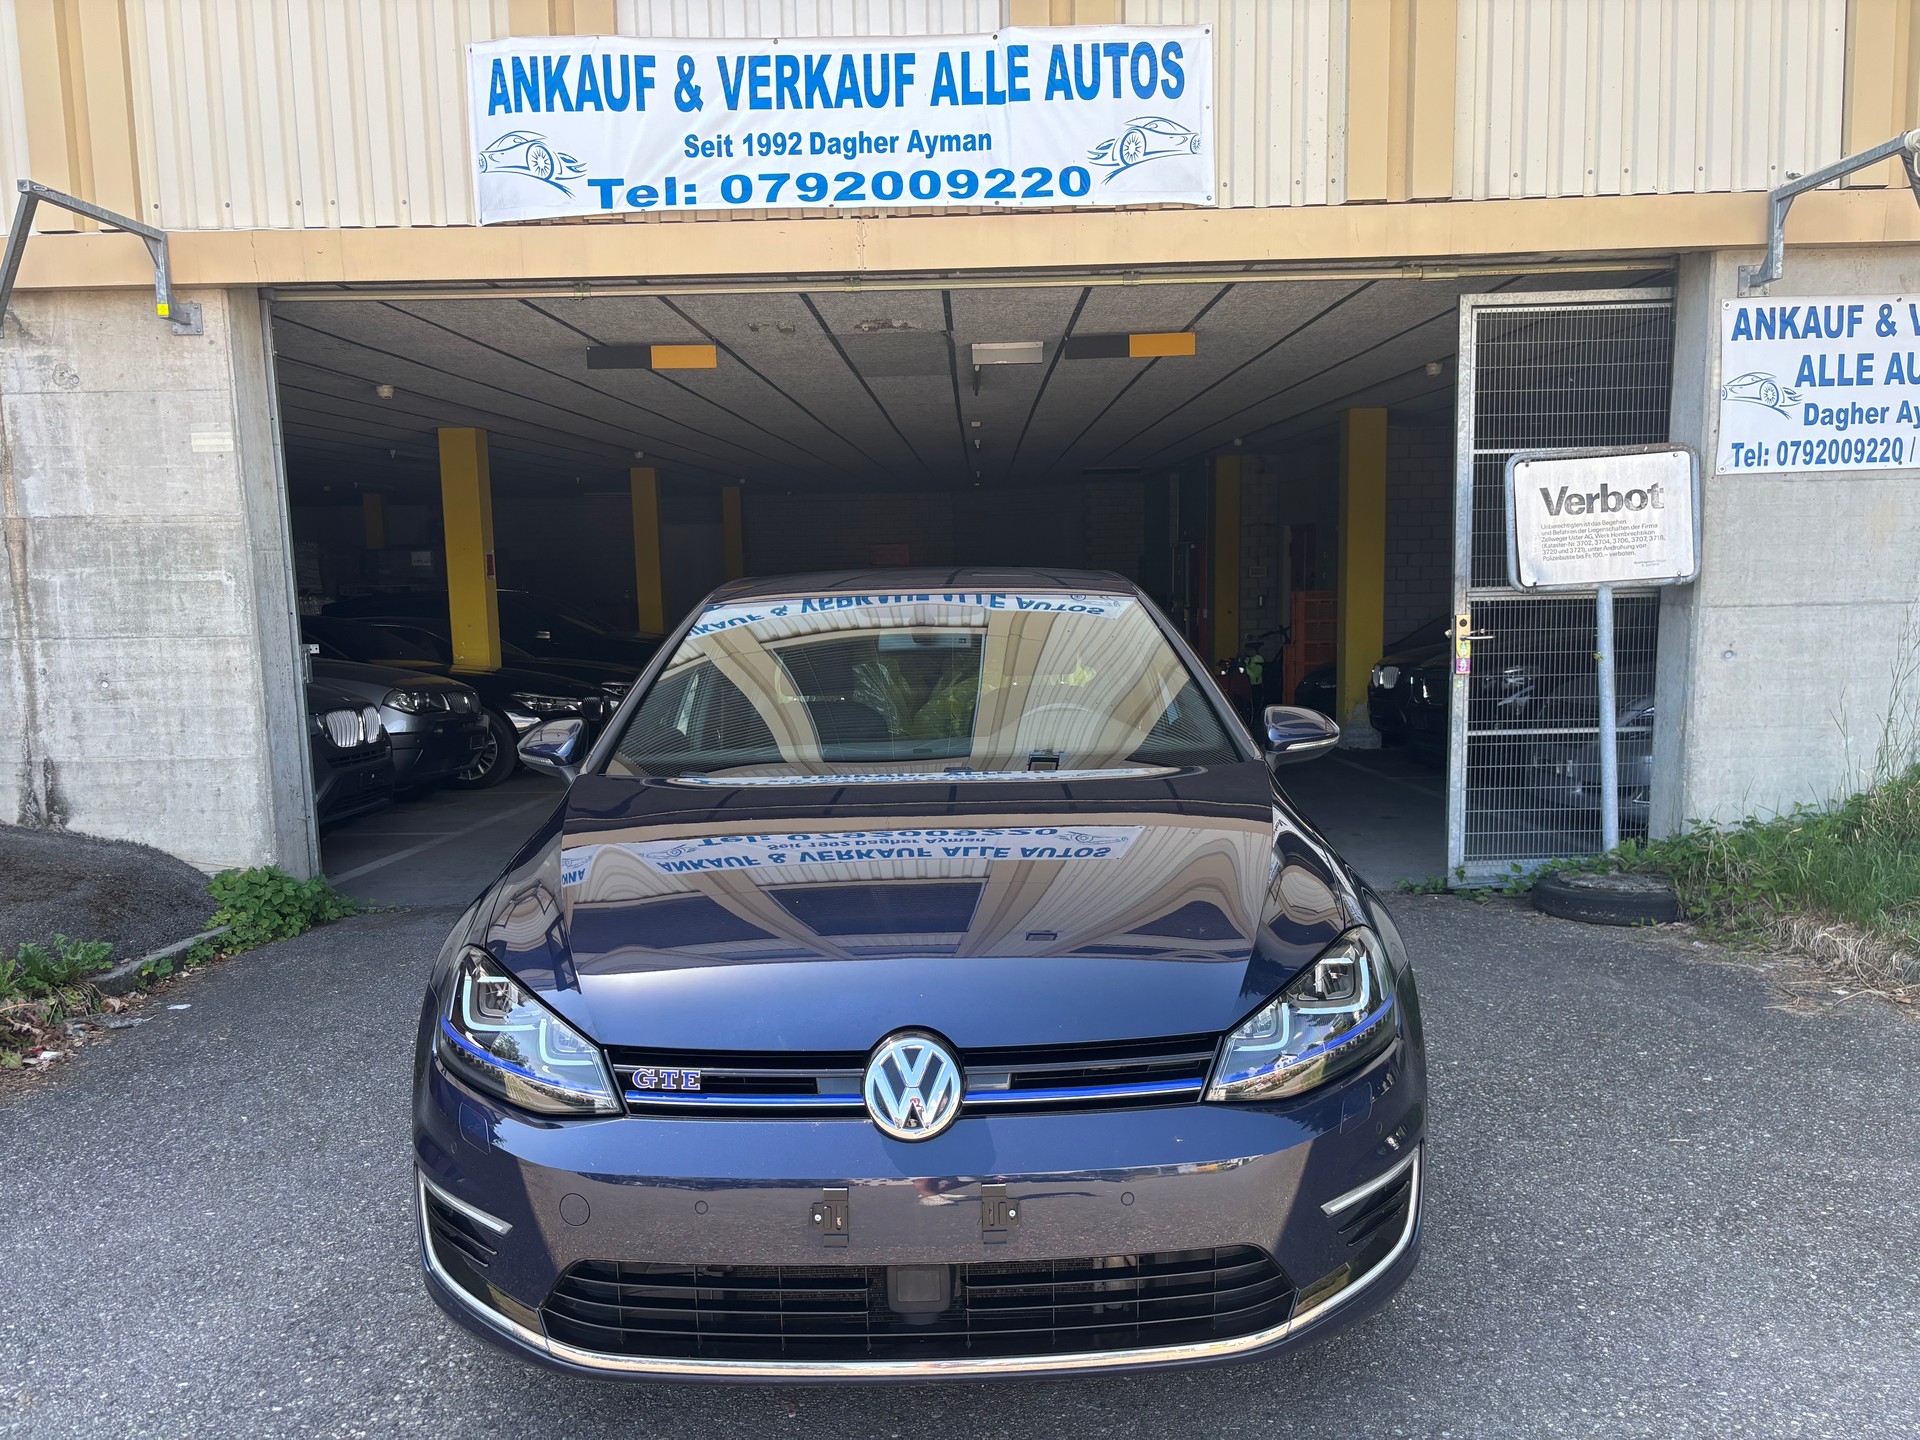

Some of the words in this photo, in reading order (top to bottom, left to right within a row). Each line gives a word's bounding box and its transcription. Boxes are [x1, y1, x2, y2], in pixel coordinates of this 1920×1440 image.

[487, 54, 656, 116] ANKAUF
[674, 54, 704, 113] &
[716, 52, 916, 112] VERKAUF
[930, 44, 1031, 107] ALLE
[1045, 40, 1186, 101] AUTOS
[684, 133, 733, 159] Seit
[742, 131, 803, 157] 1992
[809, 130, 899, 160] Dagher
[907, 129, 992, 159] Ayman
[587, 176, 697, 210] Tel:
[720, 165, 1091, 205] 0792009220
[1731, 304, 1864, 342] ANKAUF
[1875, 303, 1898, 338] &
[1794, 352, 1875, 388] ALLE
[1803, 401, 1890, 431] Dagher
[1731, 441, 1769, 468] Tel:
[1776, 436, 1904, 466] 0792009220
[1539, 481, 1665, 517] Verbot
[1587, 525, 1631, 533] Liegenschaften
[1602, 519, 1627, 527] Begehen
[1542, 554, 1576, 562] Polizeibusse
[632, 1067, 701, 1090] GTE
